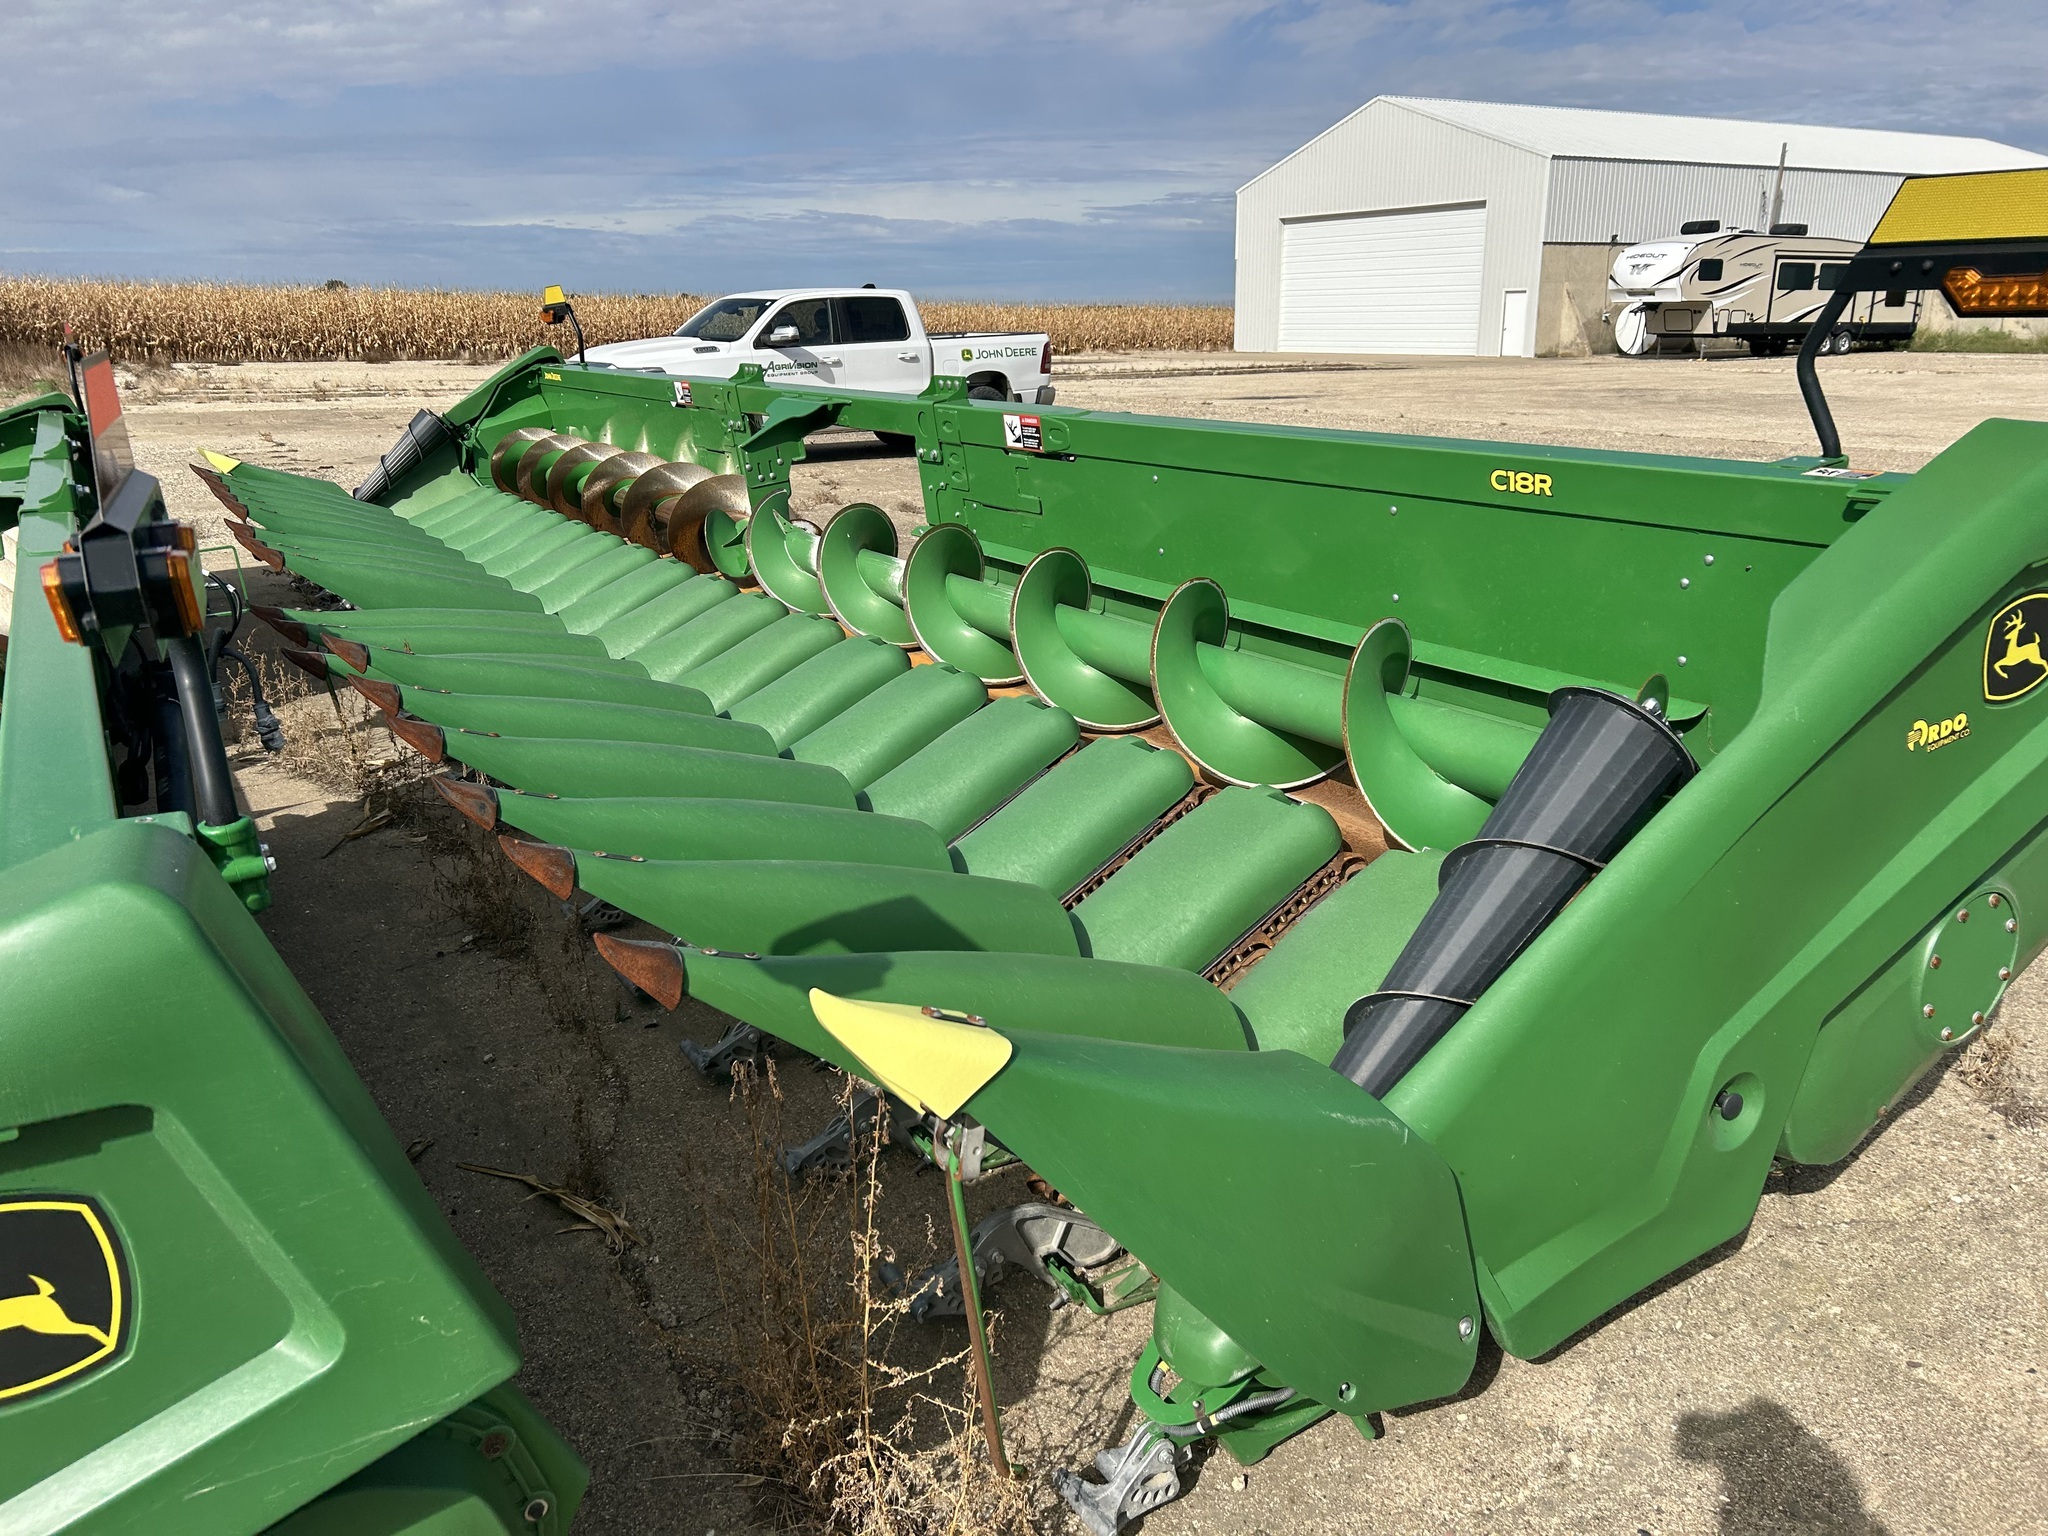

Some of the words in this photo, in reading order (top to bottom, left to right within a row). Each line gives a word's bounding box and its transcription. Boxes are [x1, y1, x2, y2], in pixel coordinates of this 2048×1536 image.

[976, 348, 1003, 359] JOHN
[1005, 347, 1037, 357] DEERE
[1490, 469, 1553, 497] C18R
